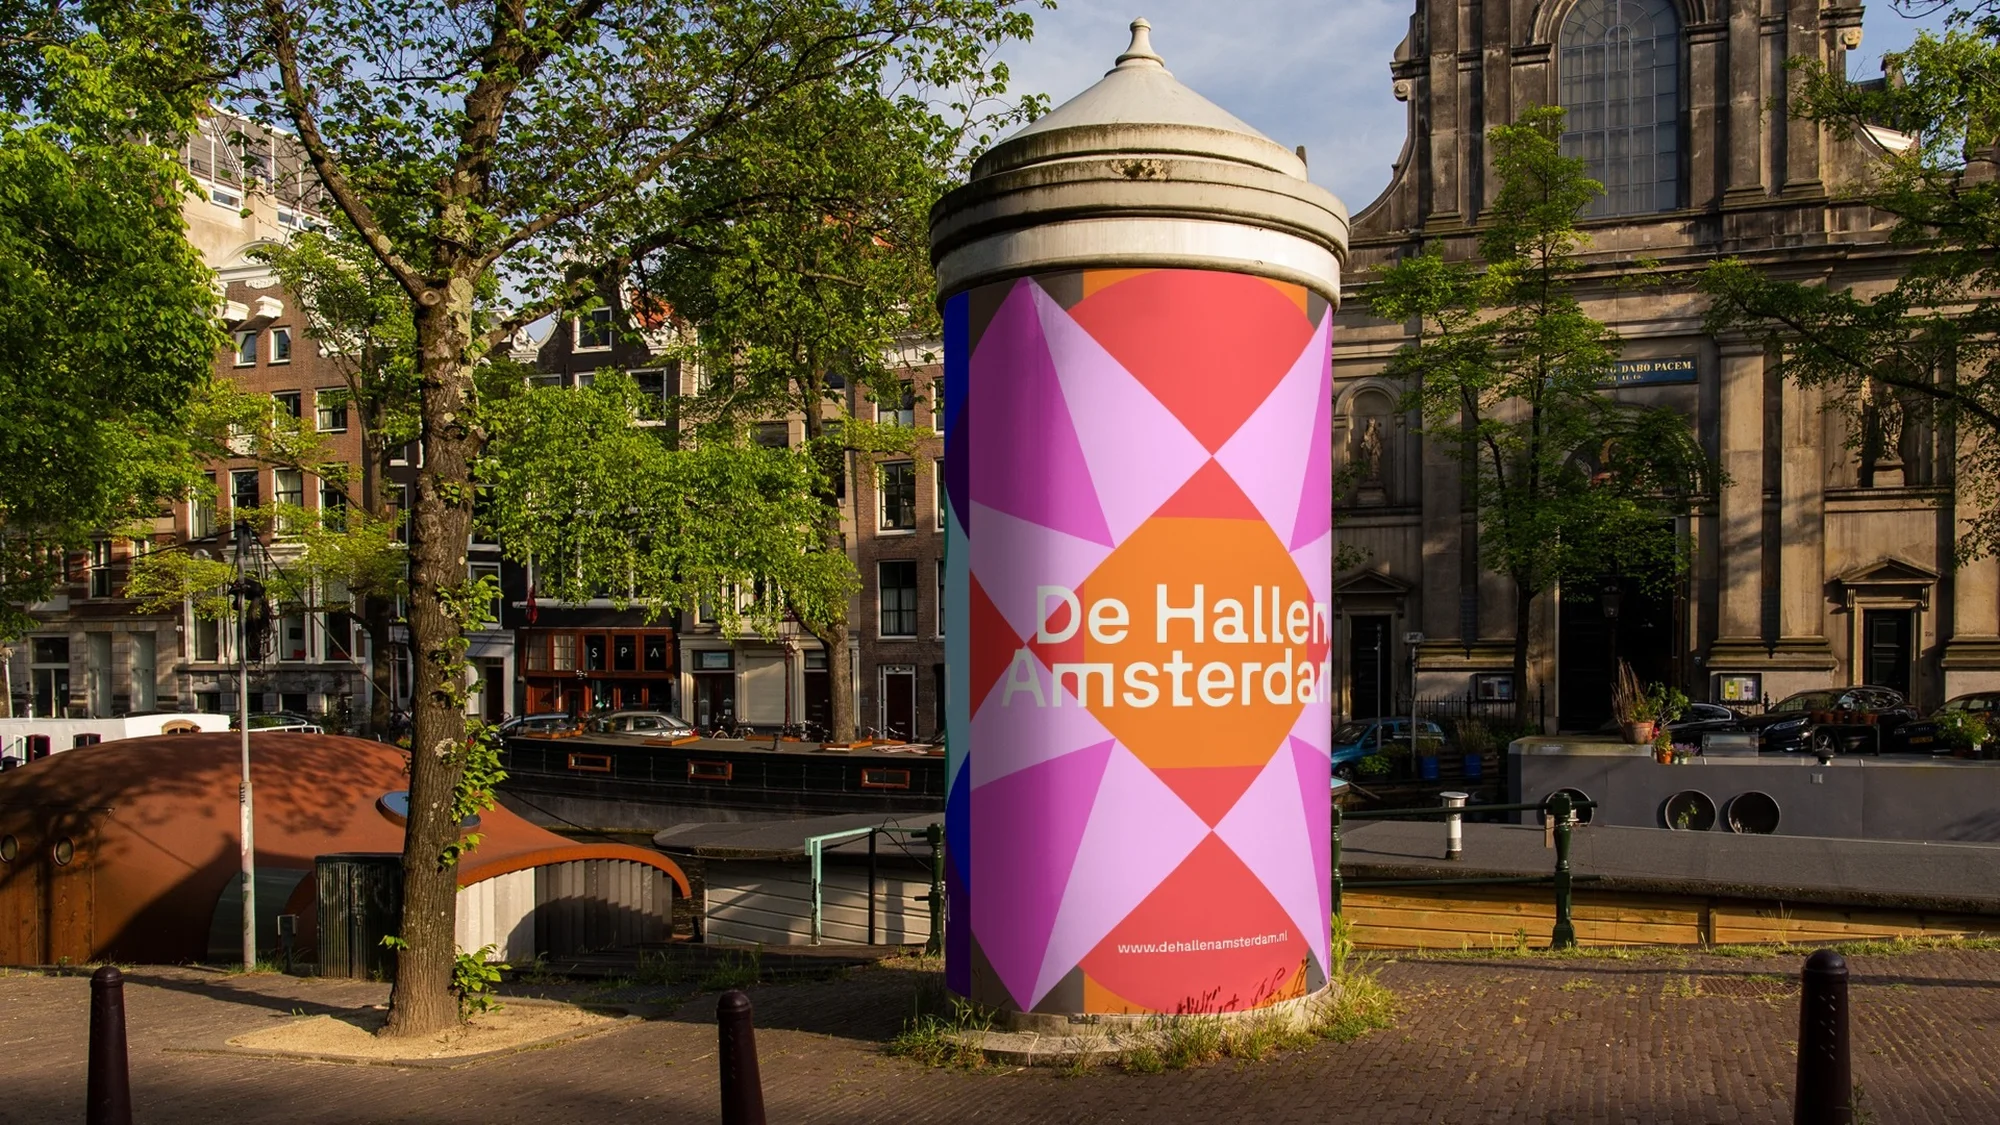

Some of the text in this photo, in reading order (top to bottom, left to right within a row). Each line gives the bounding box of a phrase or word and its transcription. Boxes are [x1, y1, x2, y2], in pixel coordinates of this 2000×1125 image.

[1037, 583, 1328, 645] De Hallen
[1117, 930, 1288, 954] www.dehallenamsterdam.nl
